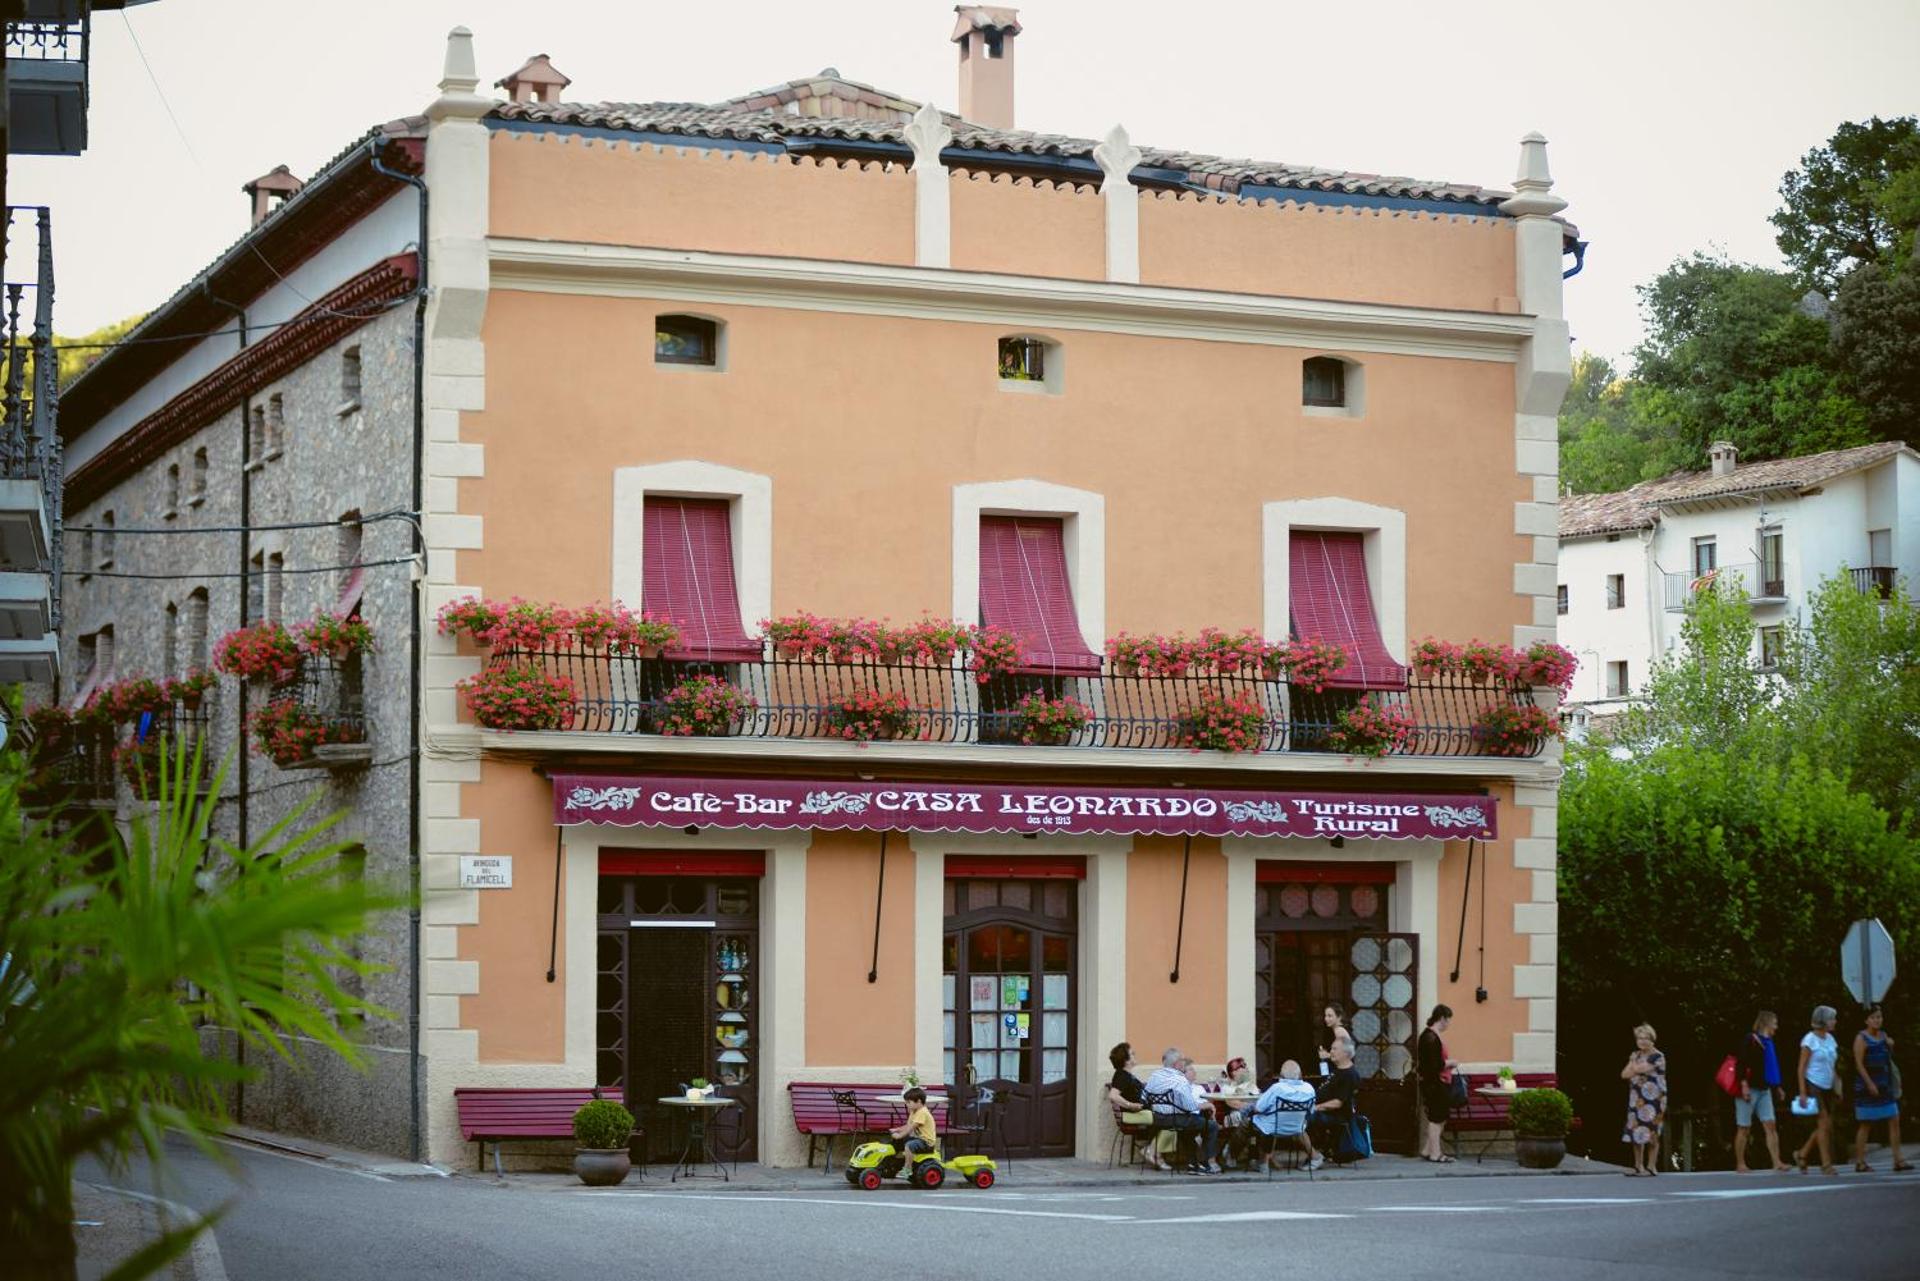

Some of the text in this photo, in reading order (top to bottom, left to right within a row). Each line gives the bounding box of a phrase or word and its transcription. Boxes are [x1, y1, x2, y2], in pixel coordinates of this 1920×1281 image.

[876, 791, 1217, 817] CASA LEONARDO
[1292, 800, 1420, 816] Turisme
[1027, 815, 1040, 824] des
[1042, 816, 1053, 824] de
[1313, 816, 1399, 832] Rural
[466, 875, 506, 884] FLAMICELL
